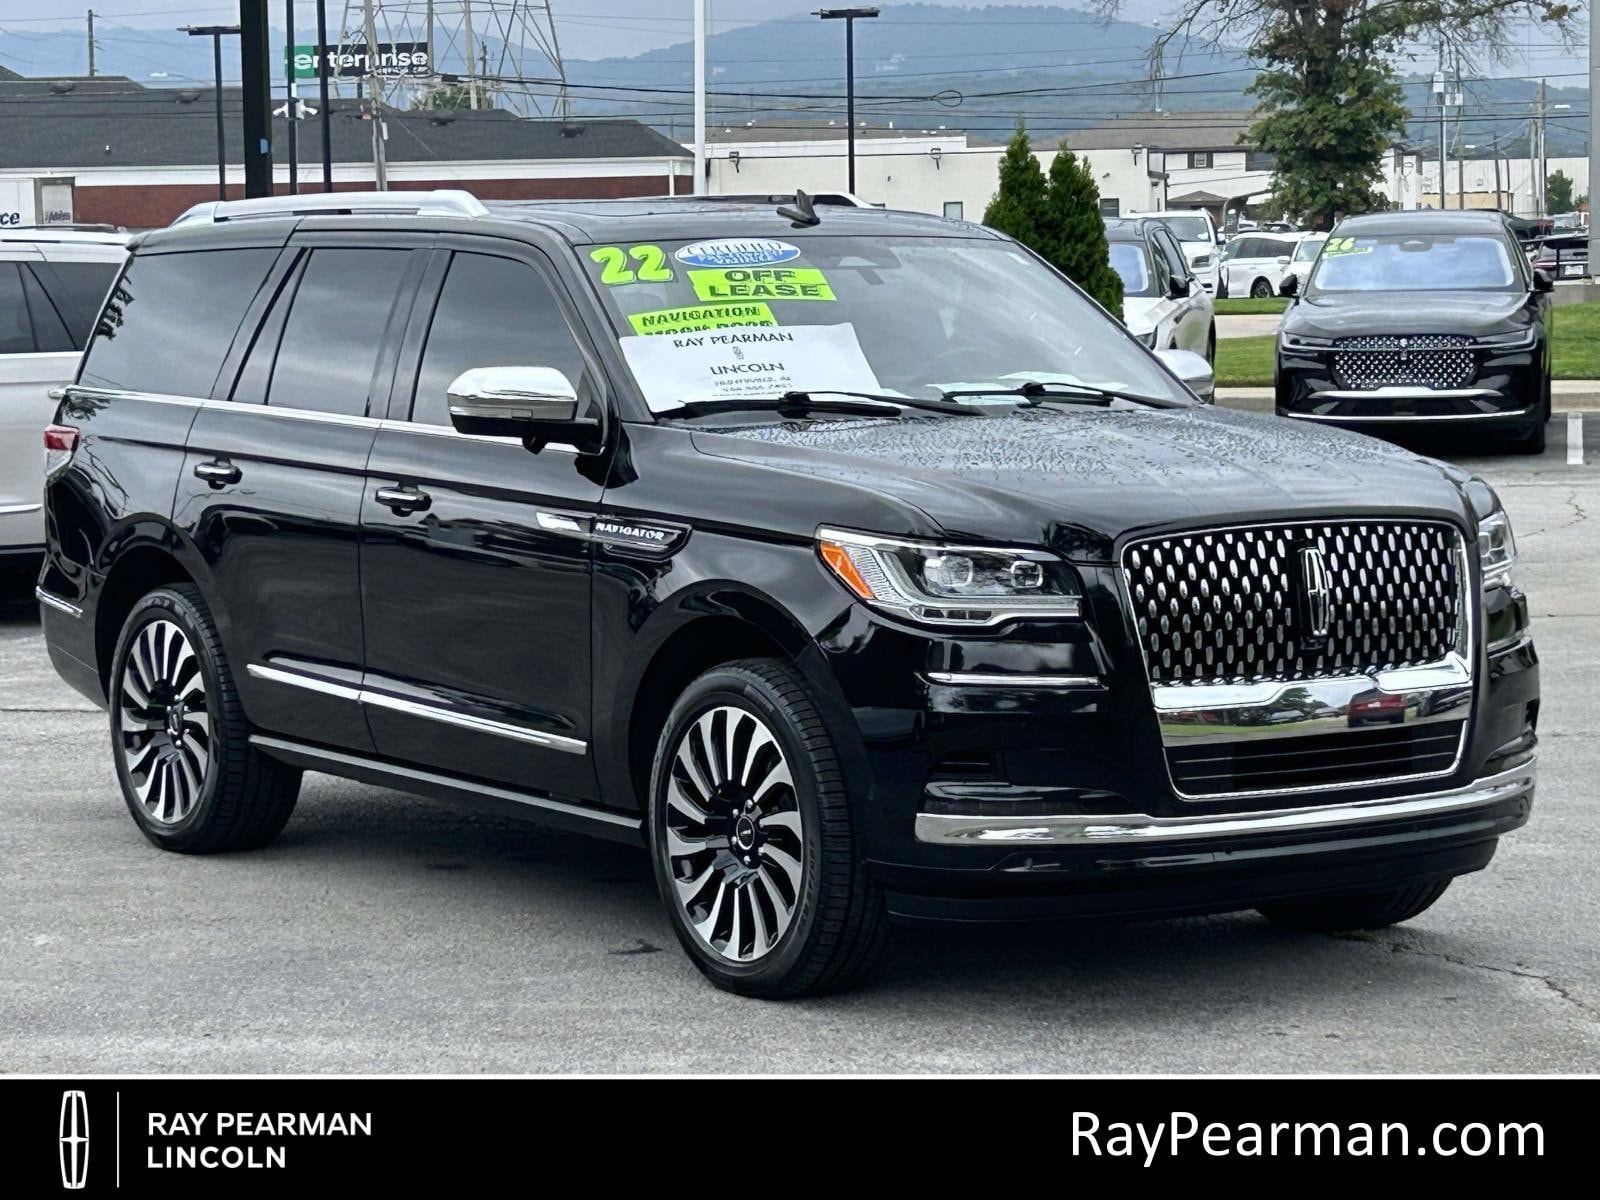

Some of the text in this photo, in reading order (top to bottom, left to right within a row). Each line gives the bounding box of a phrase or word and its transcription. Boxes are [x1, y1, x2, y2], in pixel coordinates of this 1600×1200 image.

[1325, 237, 1356, 252] 26
[589, 244, 673, 285] 22
[724, 270, 796, 283] OFF
[708, 284, 822, 298] LEASE
[641, 306, 760, 327] NAVIGATION
[673, 332, 793, 348] RAY PEARMAN
[709, 362, 785, 375] LINCOLN
[595, 522, 665, 541] NAVIGATOR
